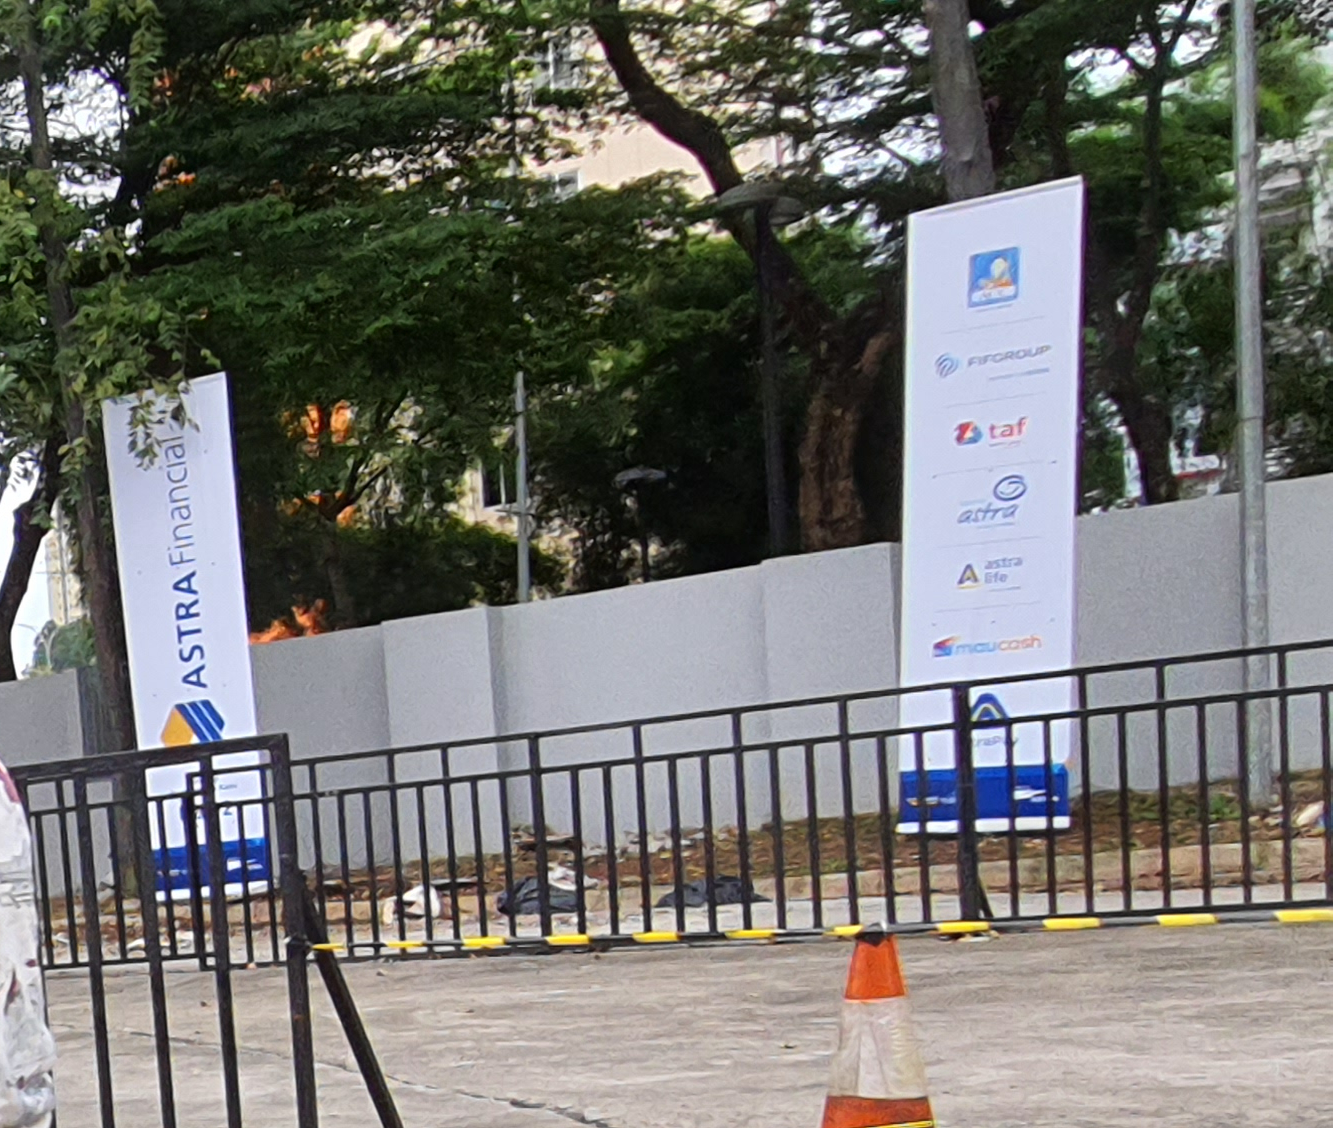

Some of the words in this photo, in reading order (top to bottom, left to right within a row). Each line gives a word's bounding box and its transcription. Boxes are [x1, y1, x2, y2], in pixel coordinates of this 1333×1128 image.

[988, 416, 1028, 440] taf
[957, 502, 1019, 524] astra
[172, 570, 208, 689] ASTRA
